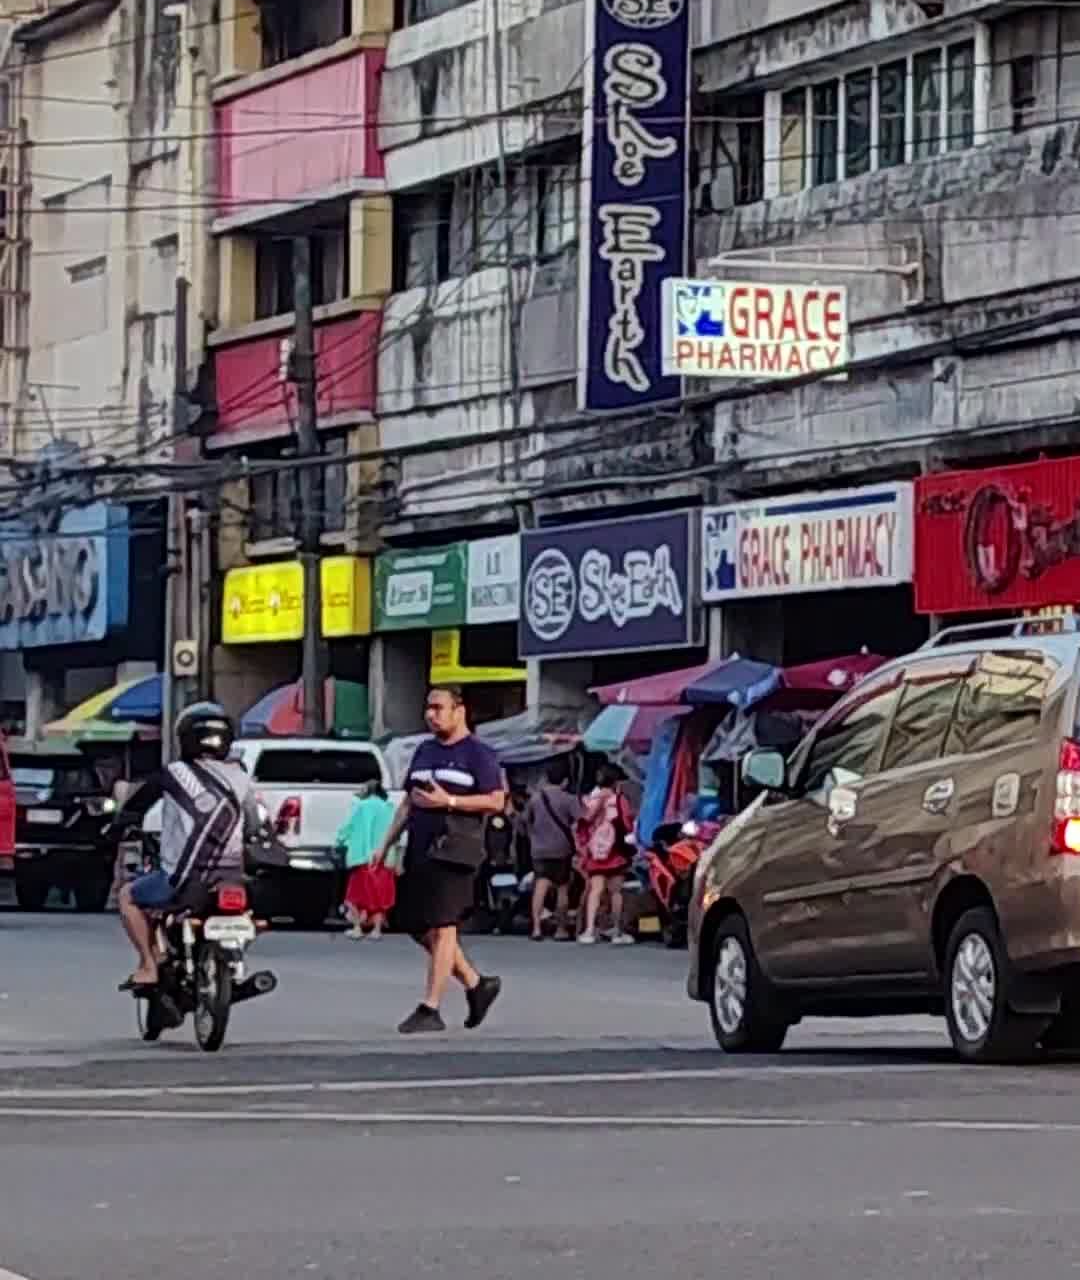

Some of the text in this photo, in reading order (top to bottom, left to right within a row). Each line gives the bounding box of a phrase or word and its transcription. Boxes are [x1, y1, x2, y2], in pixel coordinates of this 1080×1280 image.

[598, 206, 664, 390] Earth
[729, 286, 841, 342] GRACE
[676, 339, 841, 373] PHARMACY
[739, 522, 790, 589] GRACE
[799, 511, 897, 586] PHARMACY
